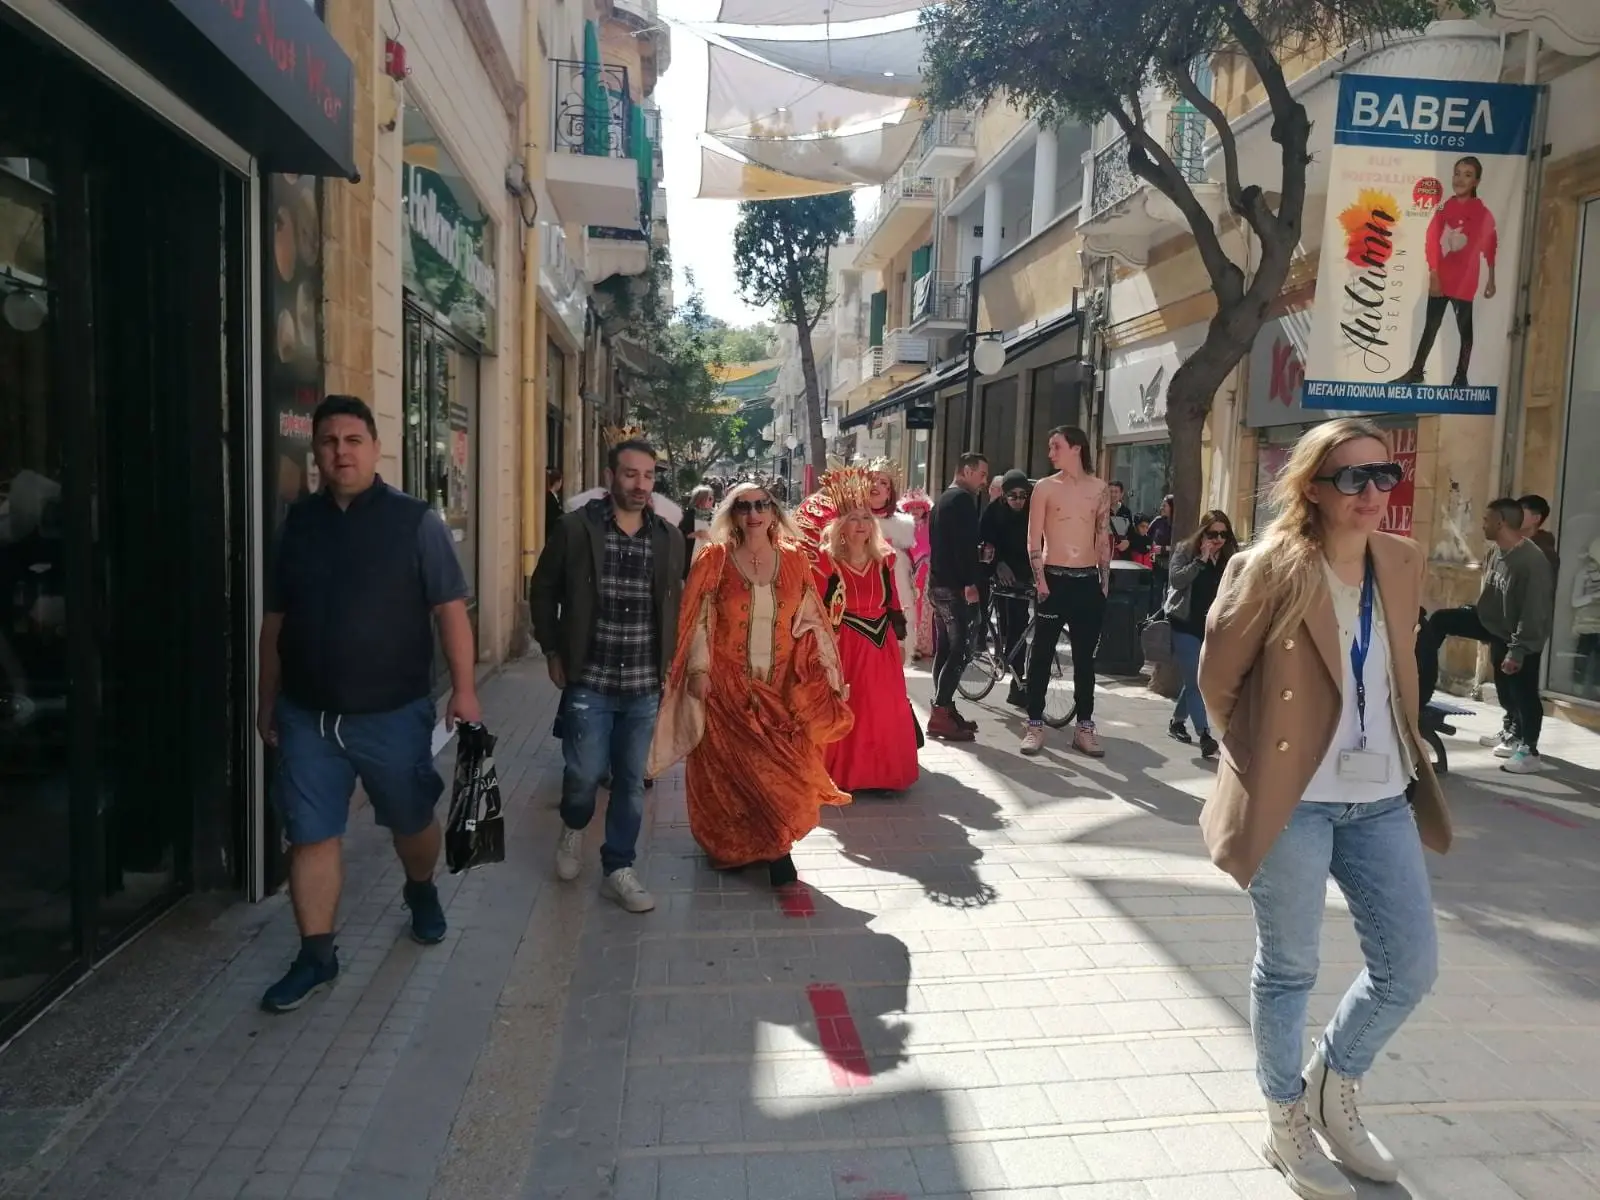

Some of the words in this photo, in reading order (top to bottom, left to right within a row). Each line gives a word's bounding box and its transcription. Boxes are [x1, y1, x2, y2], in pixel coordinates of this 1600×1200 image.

[1351, 91, 1494, 134] ΒΑΒΕΛ
[1413, 132, 1465, 147] stores
[1340, 209, 1395, 373] Autumn
[1385, 249, 1406, 332] SEASON
[1308, 383, 1345, 396] ΜΕΓΑΛΗ
[1347, 385, 1385, 398] ΠΟΙΚΙΛΙΑ
[1388, 386, 1412, 399] ΜΕΣΑ
[1416, 387, 1434, 400] ΣΤΟ
[1436, 388, 1490, 401] ΚΑΤΑΣΤΗΜΑ
[1380, 505, 1412, 531] ALE
